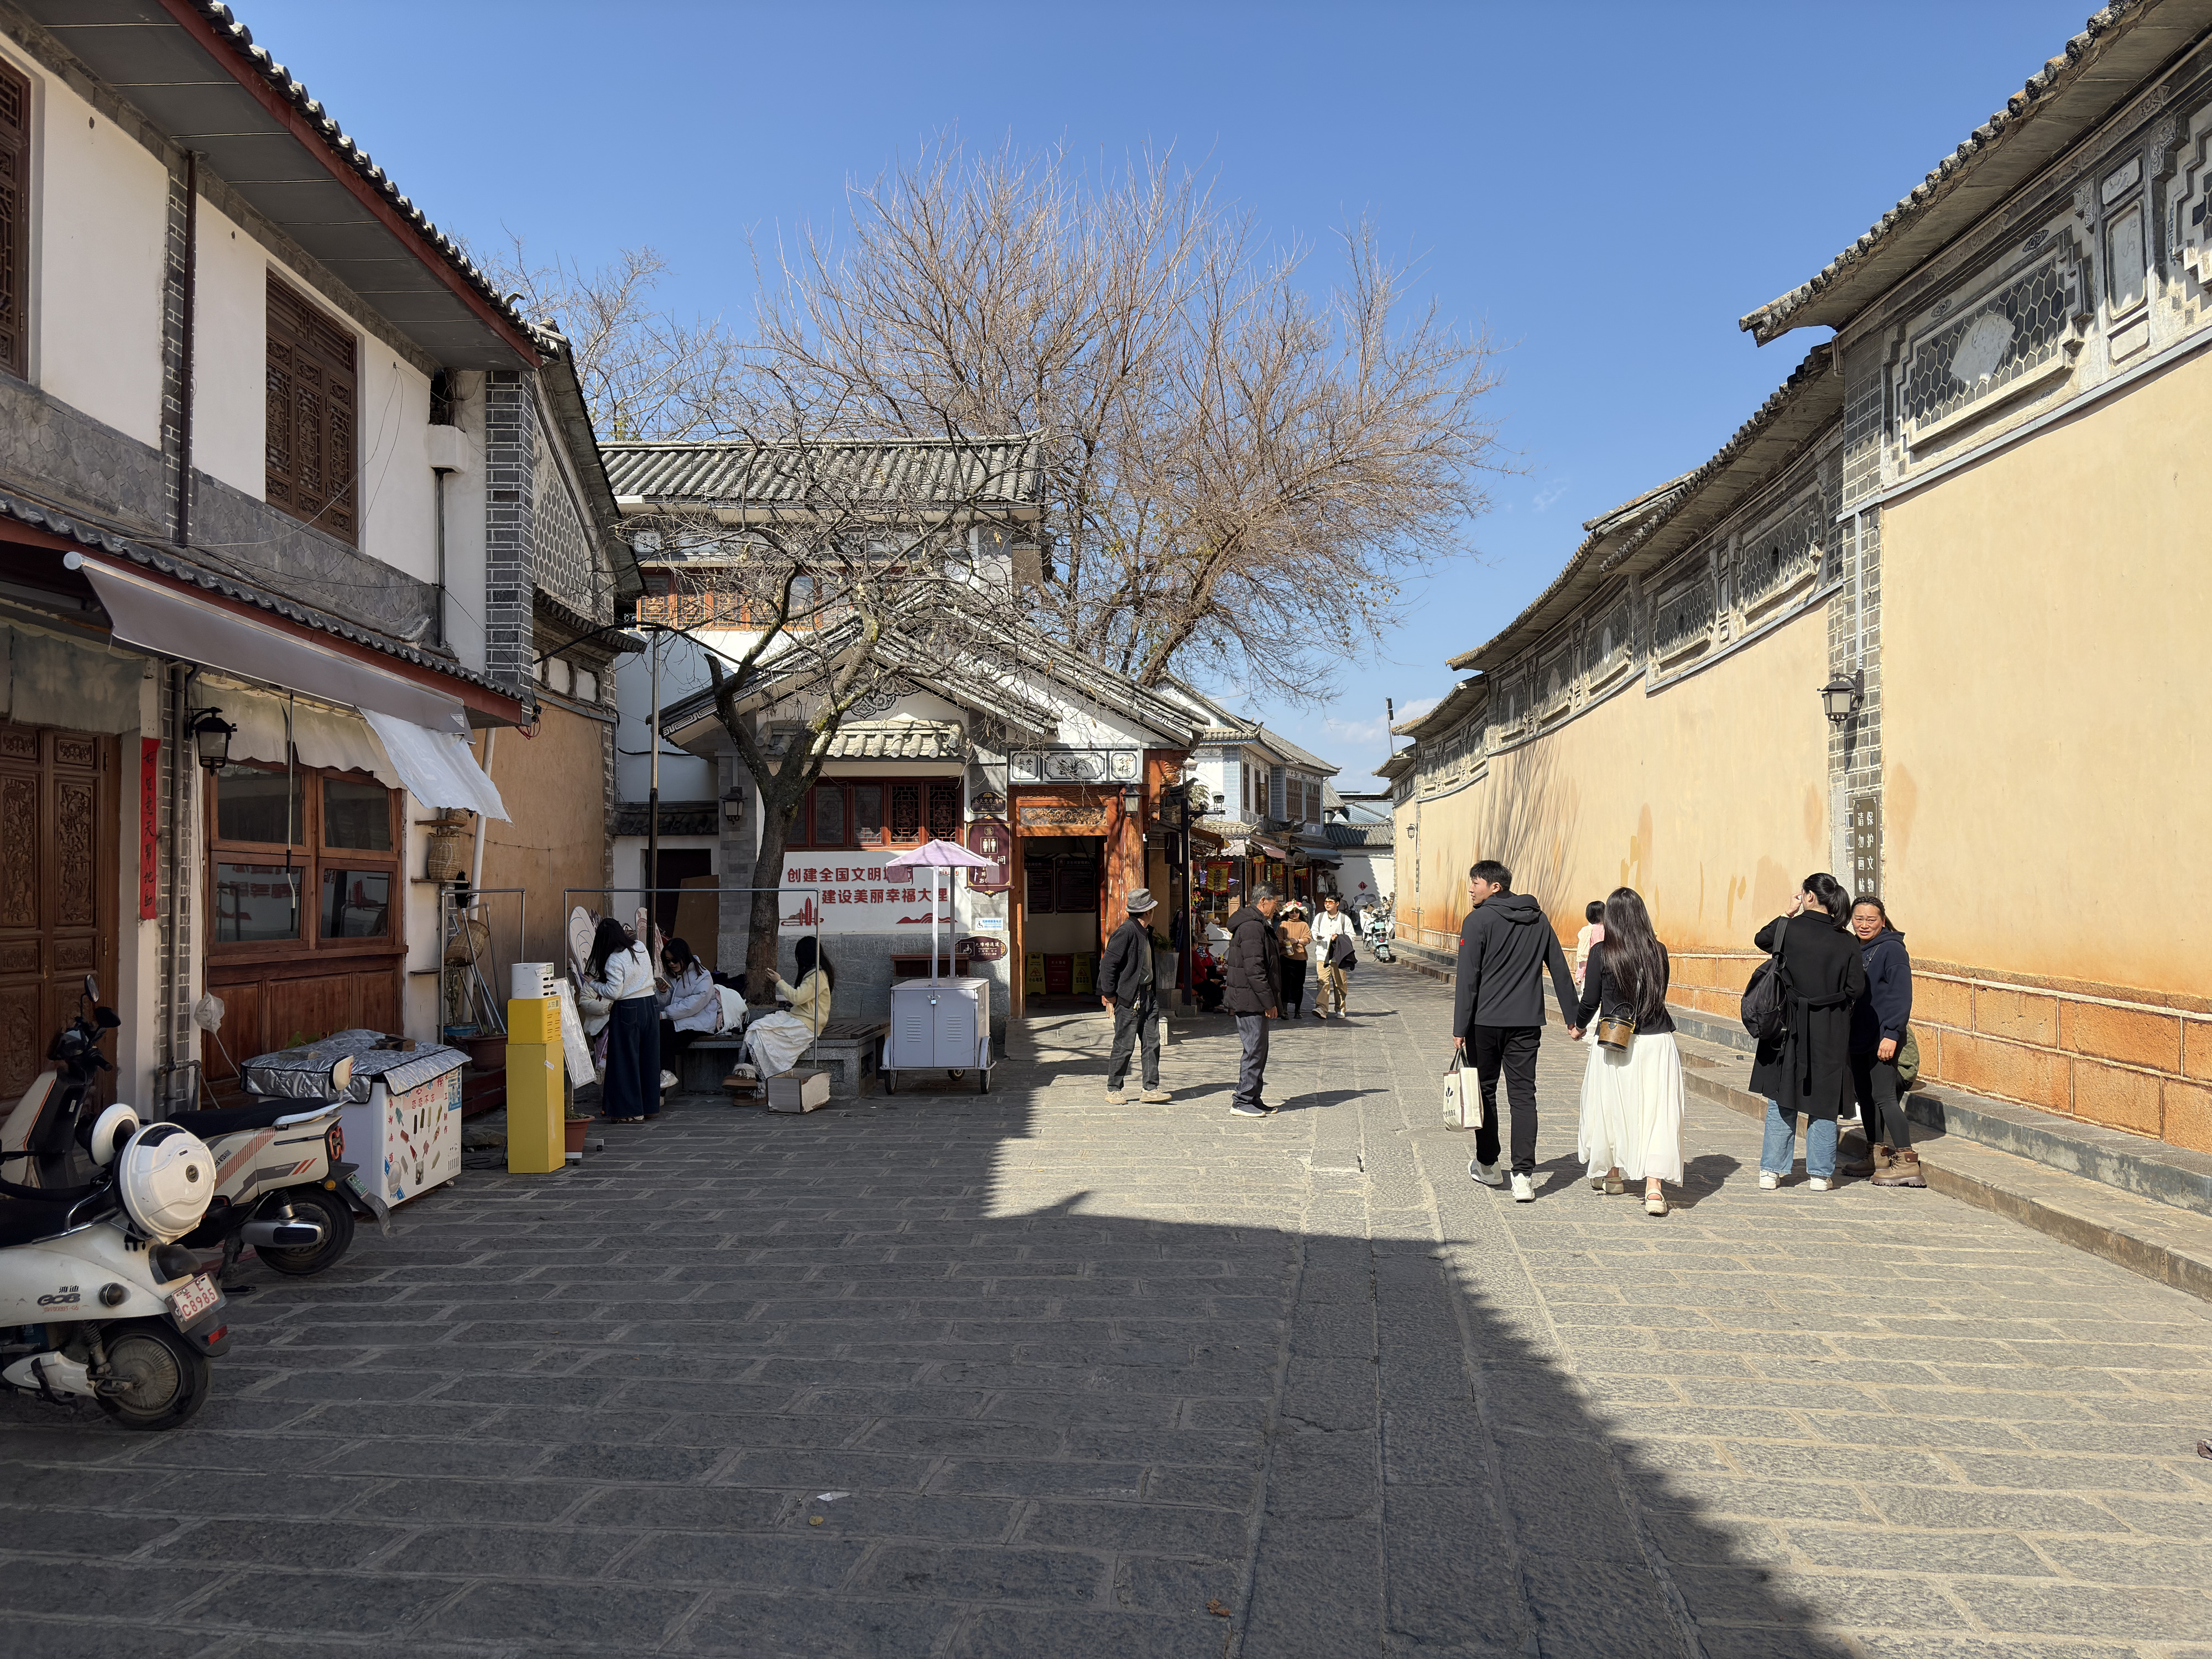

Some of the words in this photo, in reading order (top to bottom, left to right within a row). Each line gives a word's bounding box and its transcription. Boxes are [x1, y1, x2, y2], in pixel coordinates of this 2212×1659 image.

[787, 867, 912, 882] 创建全国文明
[822, 888, 948, 904] 建设美丽幸福大理
[181, 1288, 216, 1317] C8985
